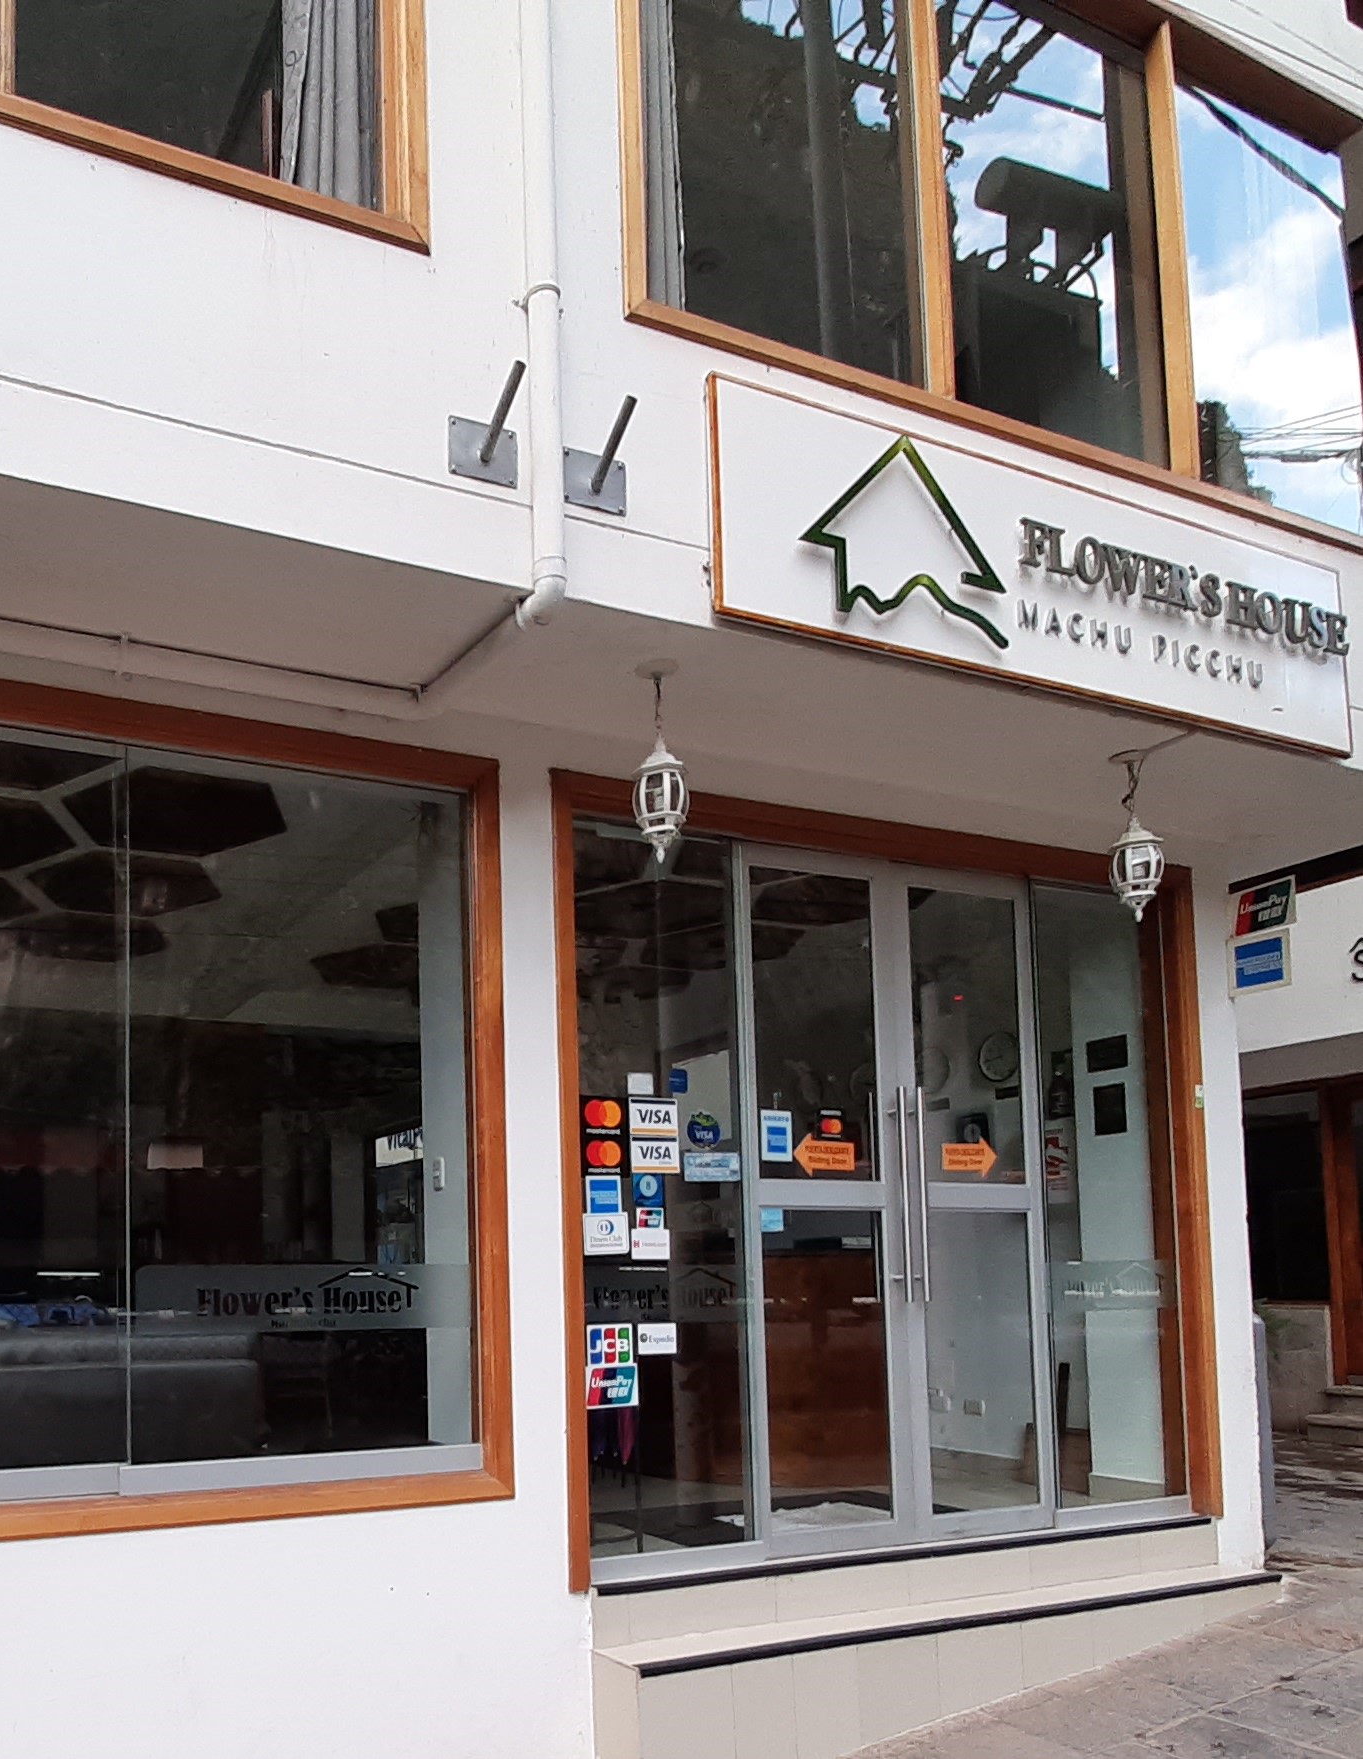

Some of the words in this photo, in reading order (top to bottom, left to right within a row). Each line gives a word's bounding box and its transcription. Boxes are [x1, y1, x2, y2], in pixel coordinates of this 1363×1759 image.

[1019, 516, 1223, 619] FLOWER'S
[1225, 580, 1350, 657] HOUSE
[1017, 599, 1132, 655] MACHU
[1151, 634, 1264, 689] PICCHU
[637, 1109, 672, 1124] VISA
[694, 1130, 714, 1140] VISA
[638, 1146, 672, 1160] VISA
[196, 1287, 313, 1317] Flower's
[323, 1287, 402, 1315] House
[590, 1339, 629, 1354] JCB
[591, 1375, 633, 1388] UnionPay
